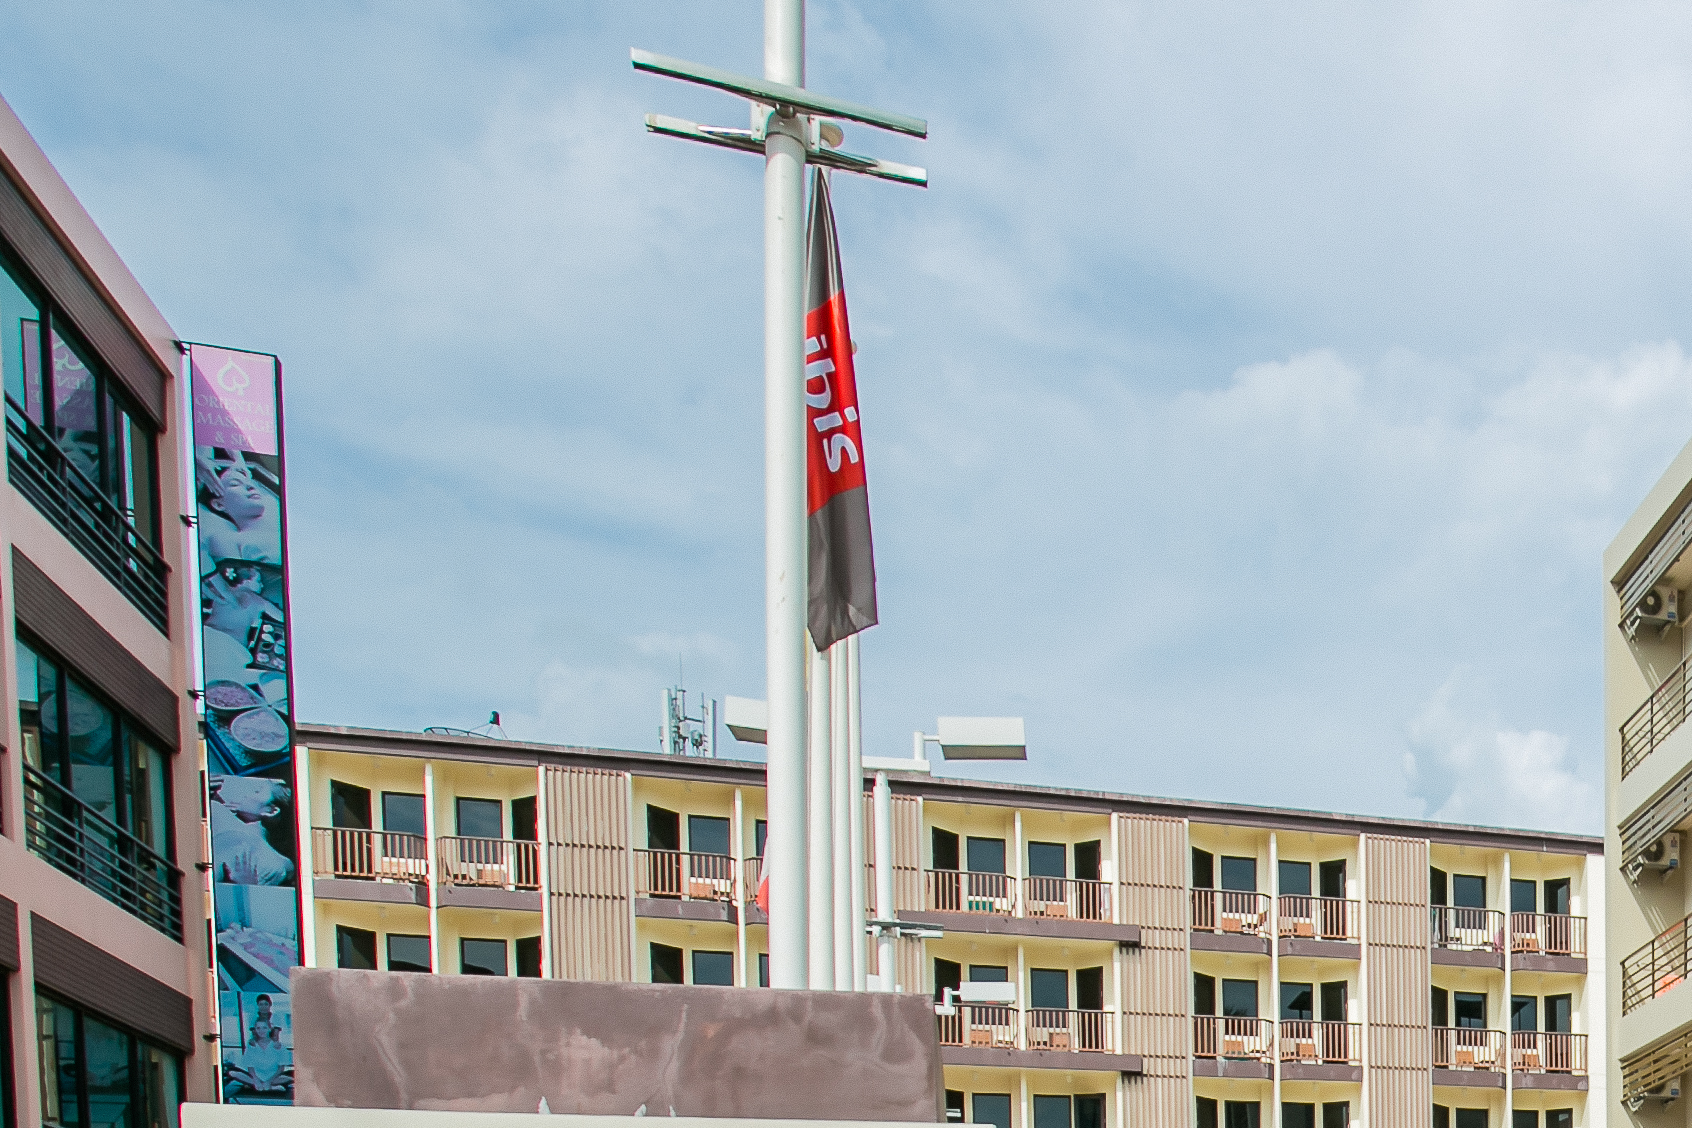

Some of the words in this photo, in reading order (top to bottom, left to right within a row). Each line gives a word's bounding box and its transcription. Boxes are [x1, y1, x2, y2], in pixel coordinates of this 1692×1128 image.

[195, 394, 271, 417] ORIENTAL
[805, 334, 860, 473] ibis
[197, 411, 272, 433] MASSAGE
[215, 431, 225, 444] &
[231, 433, 254, 448] SPA
